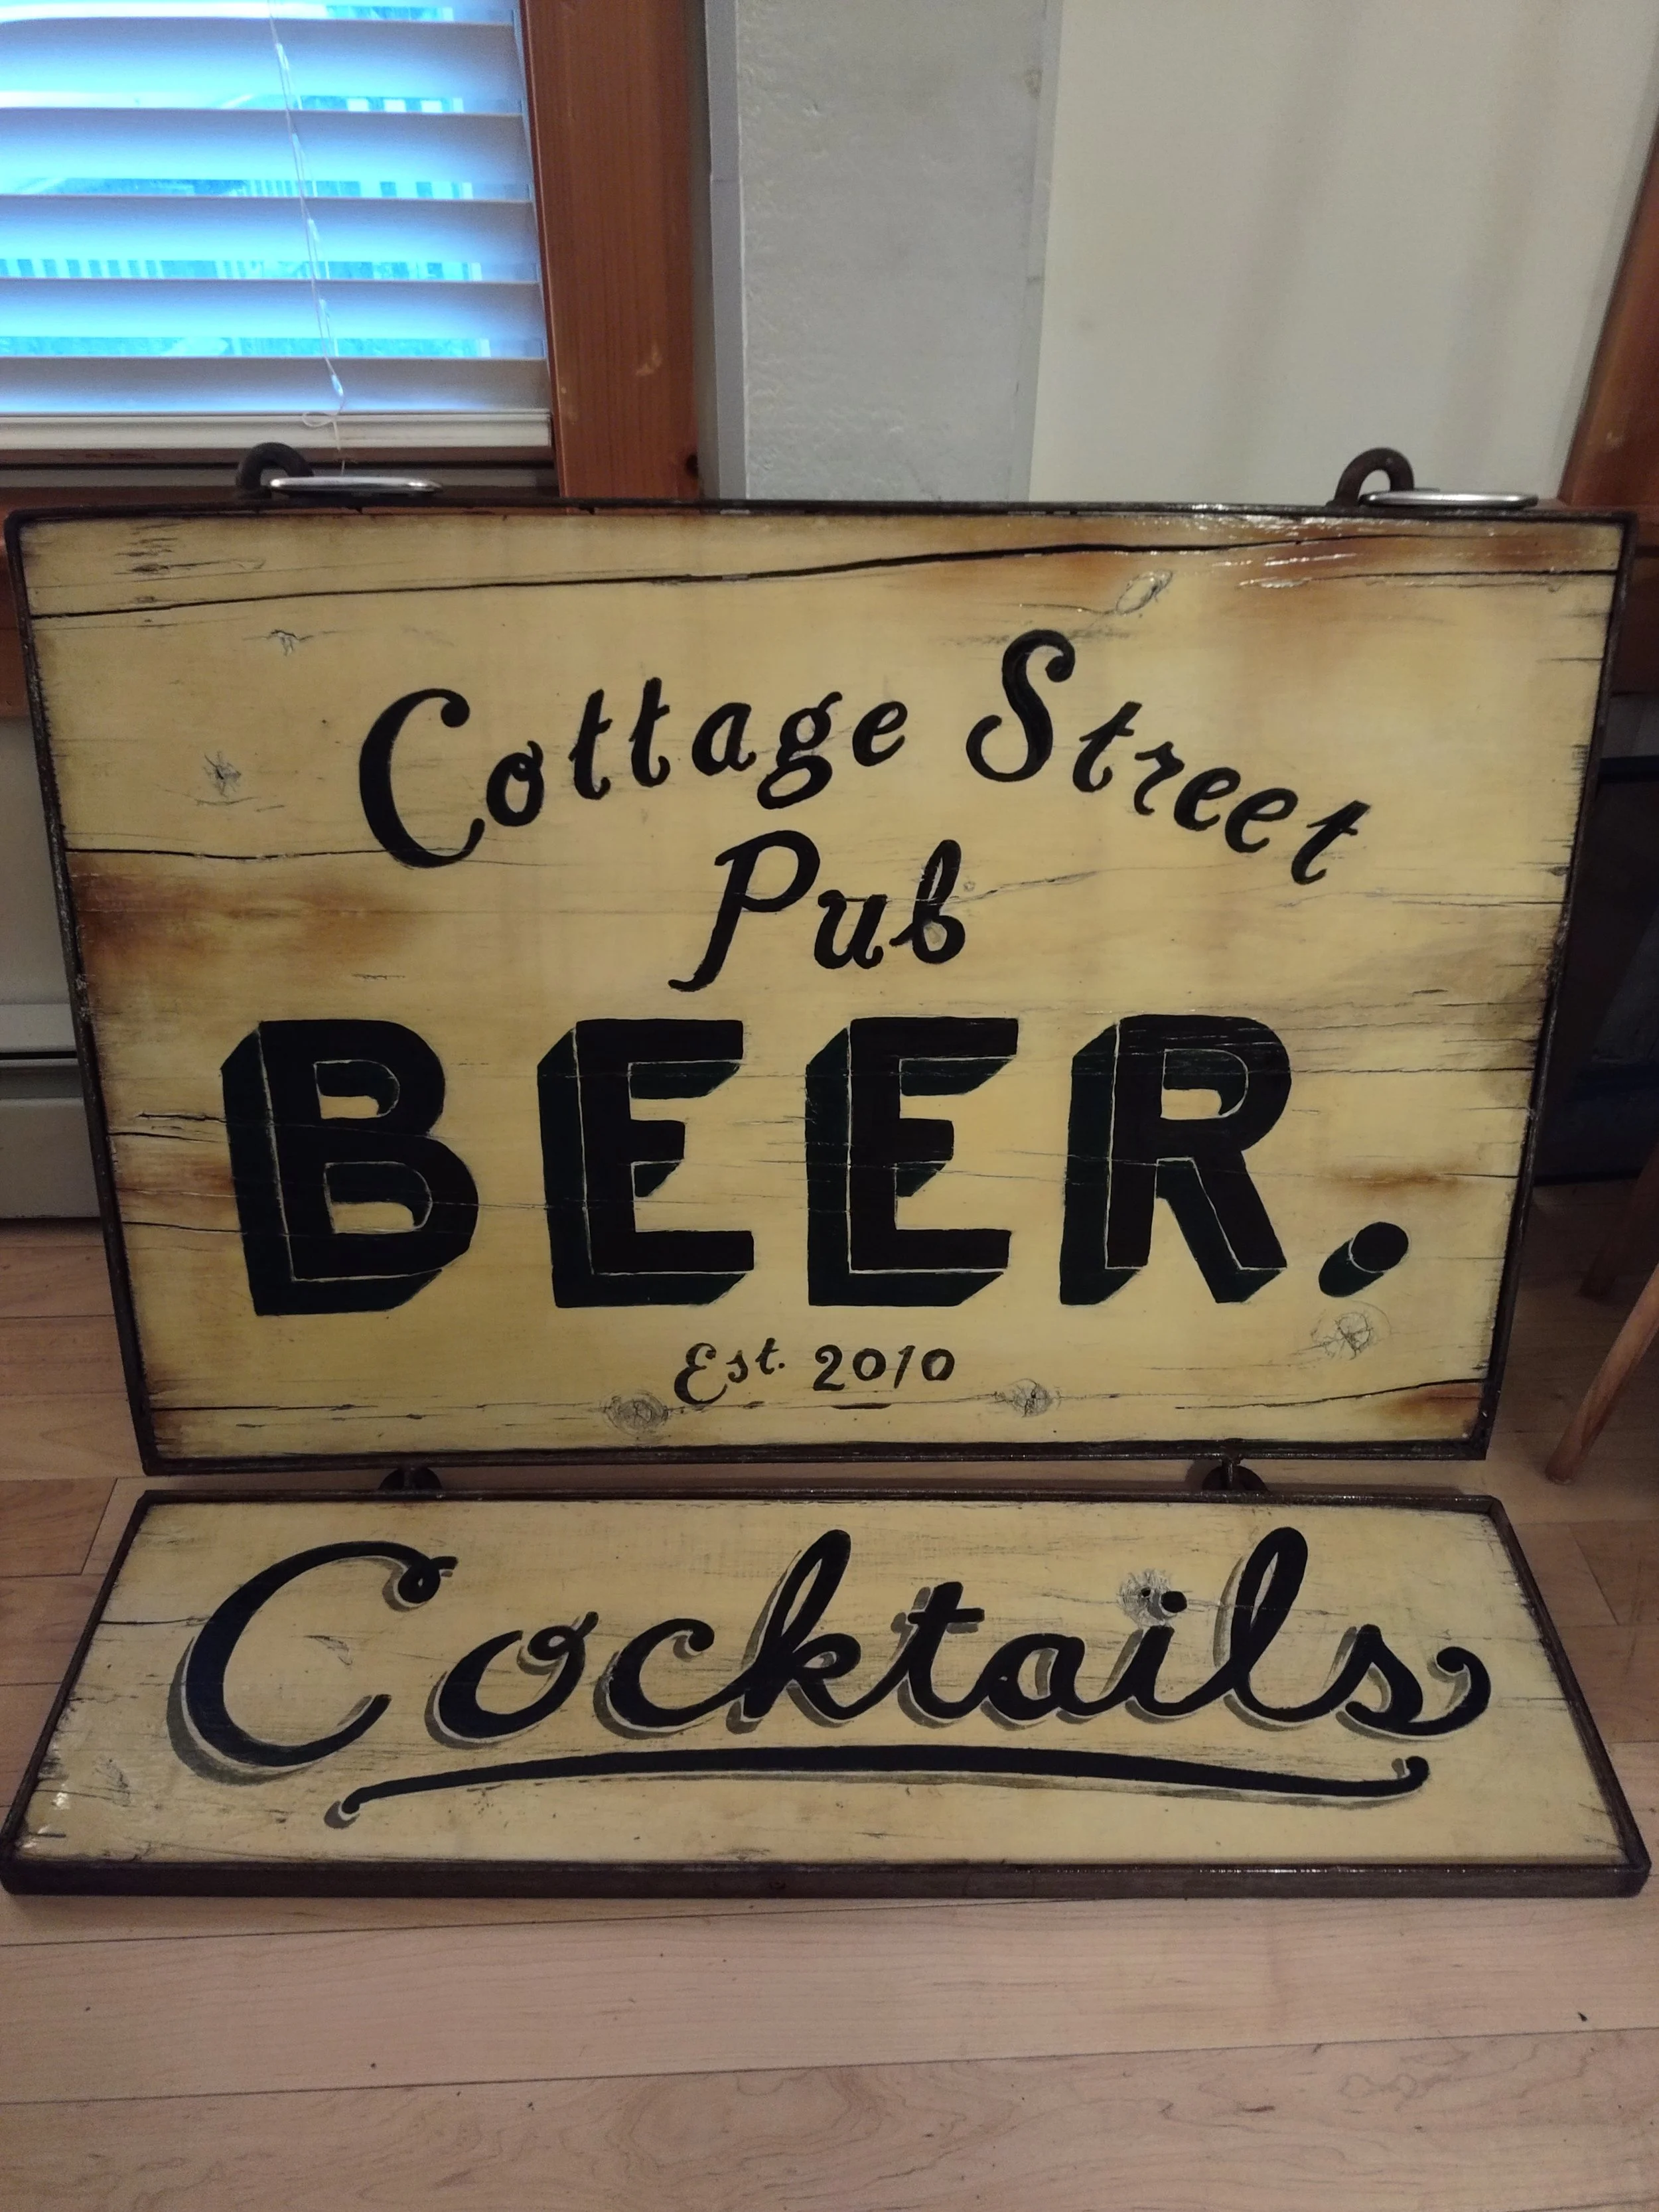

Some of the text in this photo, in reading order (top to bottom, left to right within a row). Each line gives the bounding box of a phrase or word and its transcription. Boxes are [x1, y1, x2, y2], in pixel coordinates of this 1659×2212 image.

[358, 628, 1371, 885] Cottage Street
[667, 830, 966, 992] Pub
[220, 1013, 1409, 1317] BEER.
[673, 1337, 956, 1406] Est. 2010
[174, 1526, 1490, 1780] Cocktails
